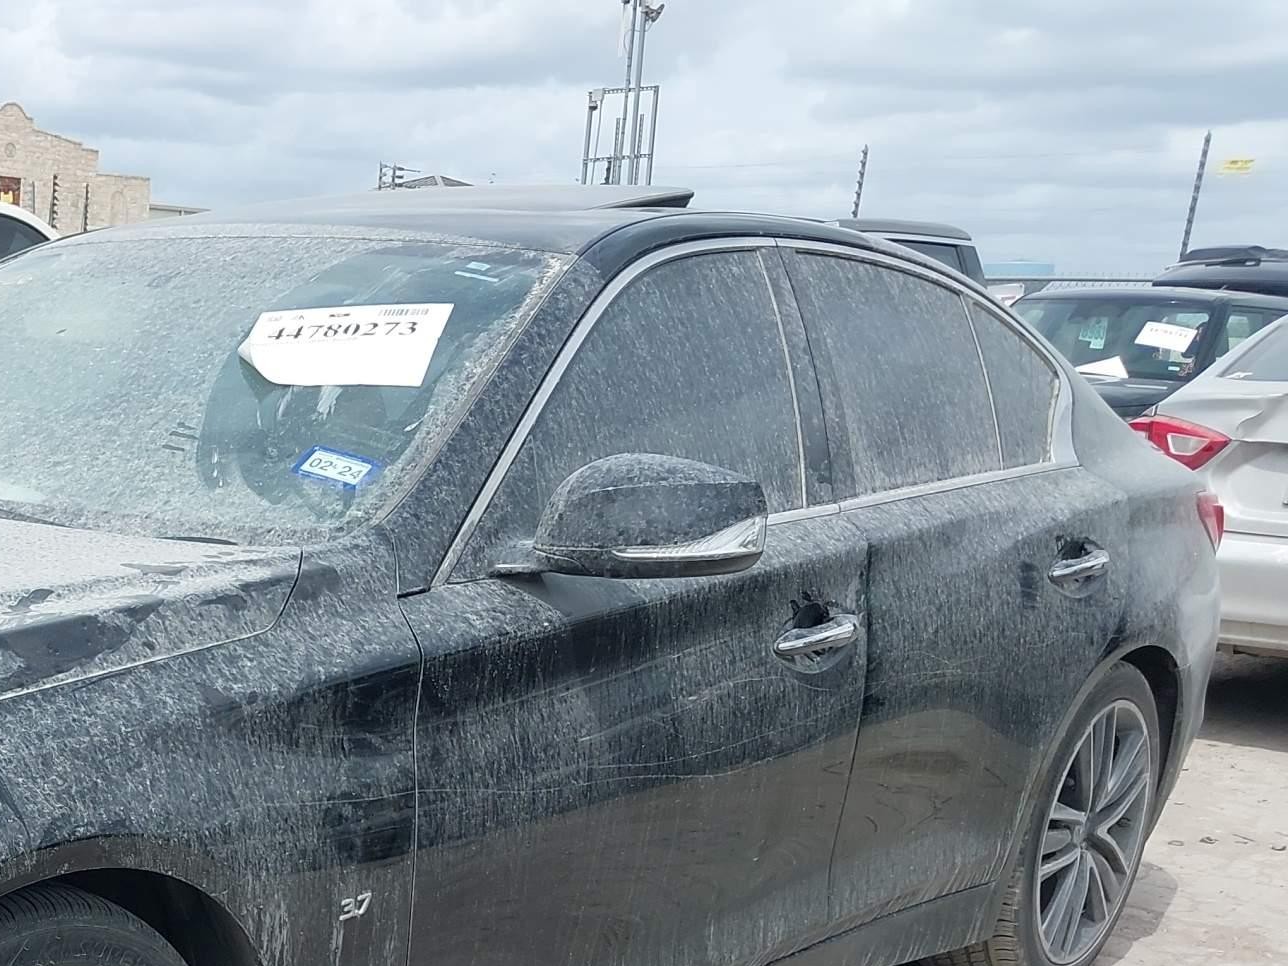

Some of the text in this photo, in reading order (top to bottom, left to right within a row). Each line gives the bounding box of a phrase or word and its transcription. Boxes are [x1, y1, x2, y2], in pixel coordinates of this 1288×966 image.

[268, 321, 418, 340] 44780273
[309, 457, 335, 472] 02
[336, 465, 363, 480] 24
